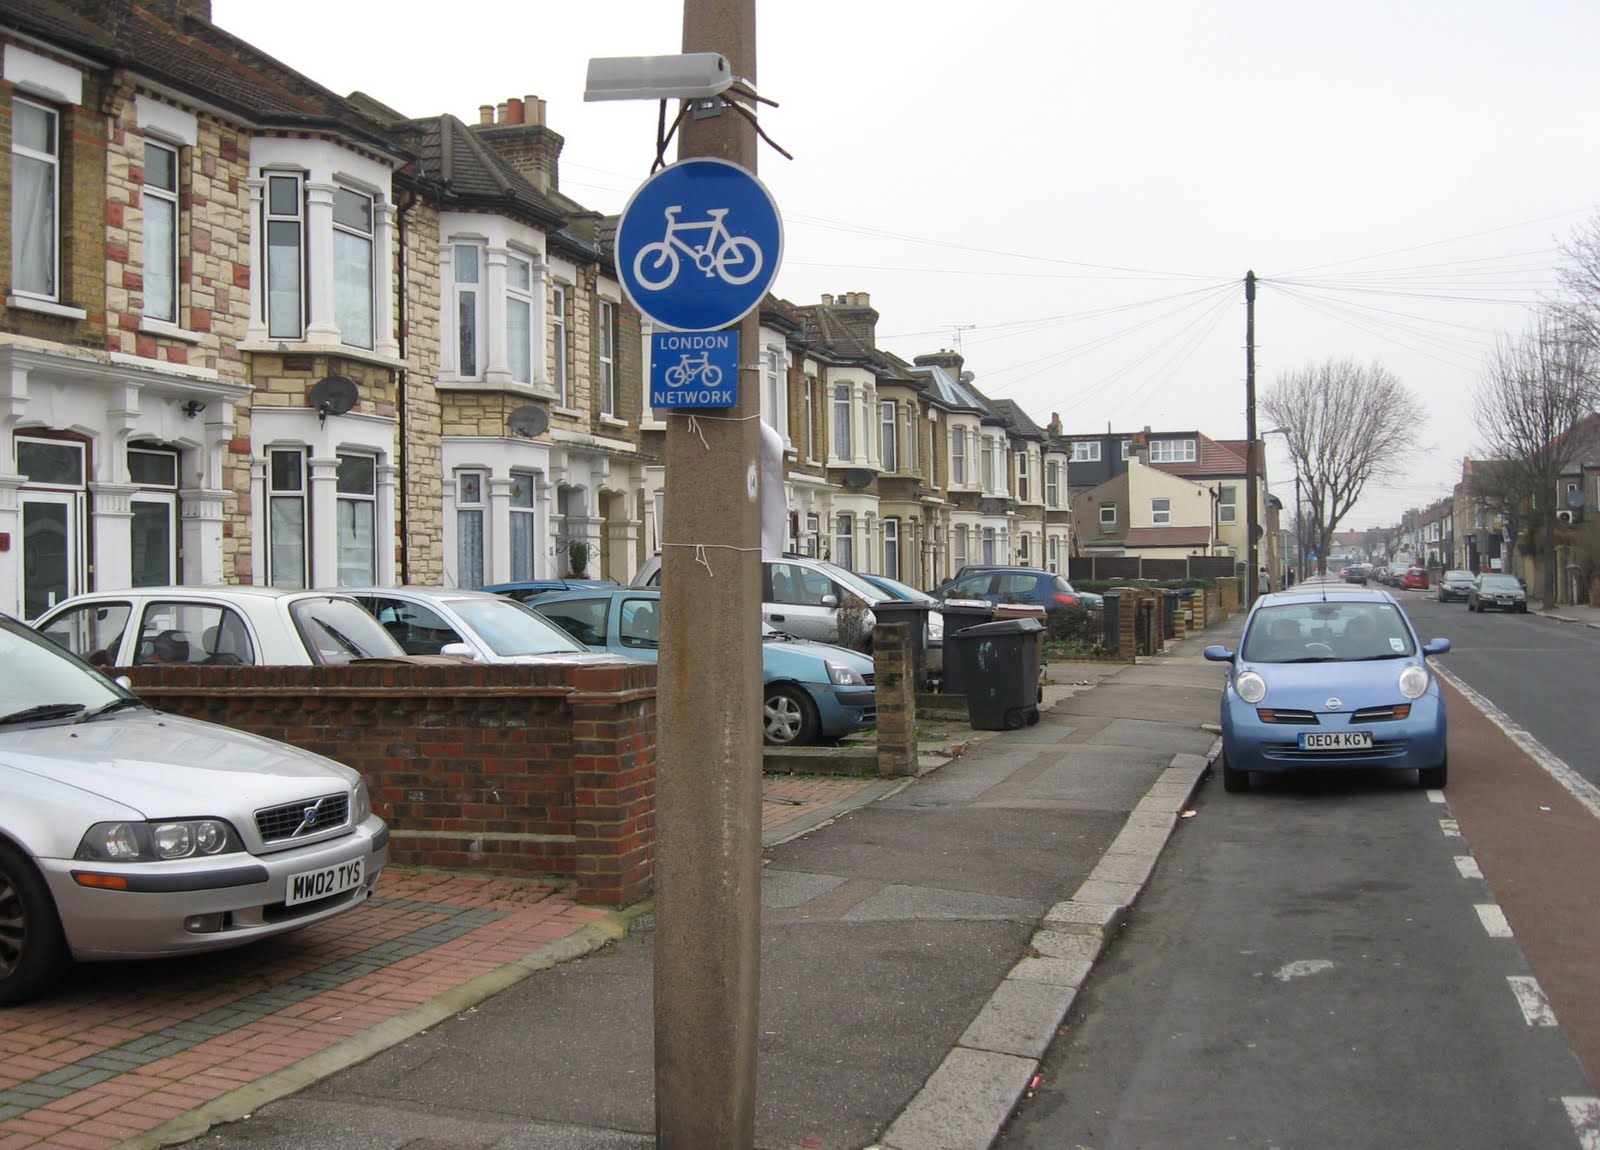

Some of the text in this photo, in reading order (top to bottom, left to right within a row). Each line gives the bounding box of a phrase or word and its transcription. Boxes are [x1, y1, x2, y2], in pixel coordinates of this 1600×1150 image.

[660, 336, 729, 350] LONDON
[654, 390, 732, 404] NETWORK
[293, 860, 361, 901] MW02 TYS
